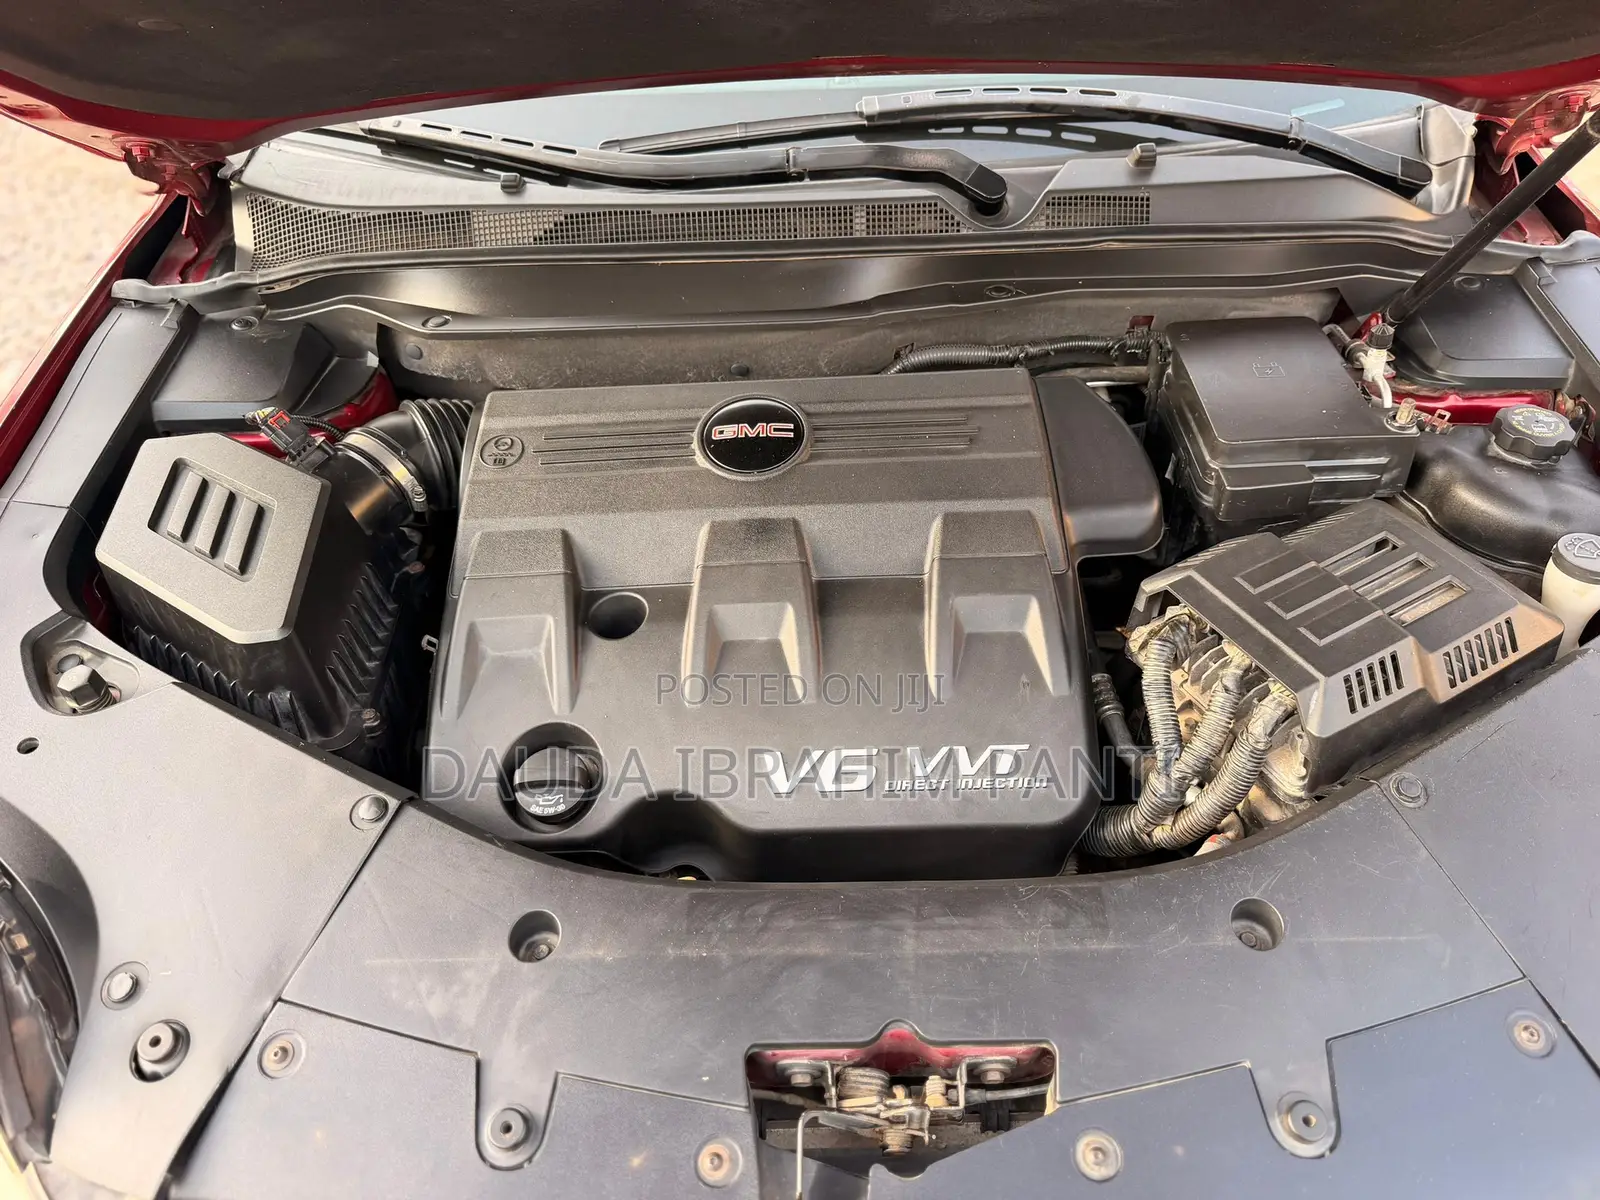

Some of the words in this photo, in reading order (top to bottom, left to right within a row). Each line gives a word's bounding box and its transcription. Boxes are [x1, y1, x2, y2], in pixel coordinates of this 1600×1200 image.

[712, 422, 794, 440] GMC
[764, 748, 879, 795] V6
[907, 744, 1031, 777] VVT
[884, 779, 950, 793] DIRECT
[956, 776, 1049, 791] INJECTION
[530, 804, 545, 814] SAE
